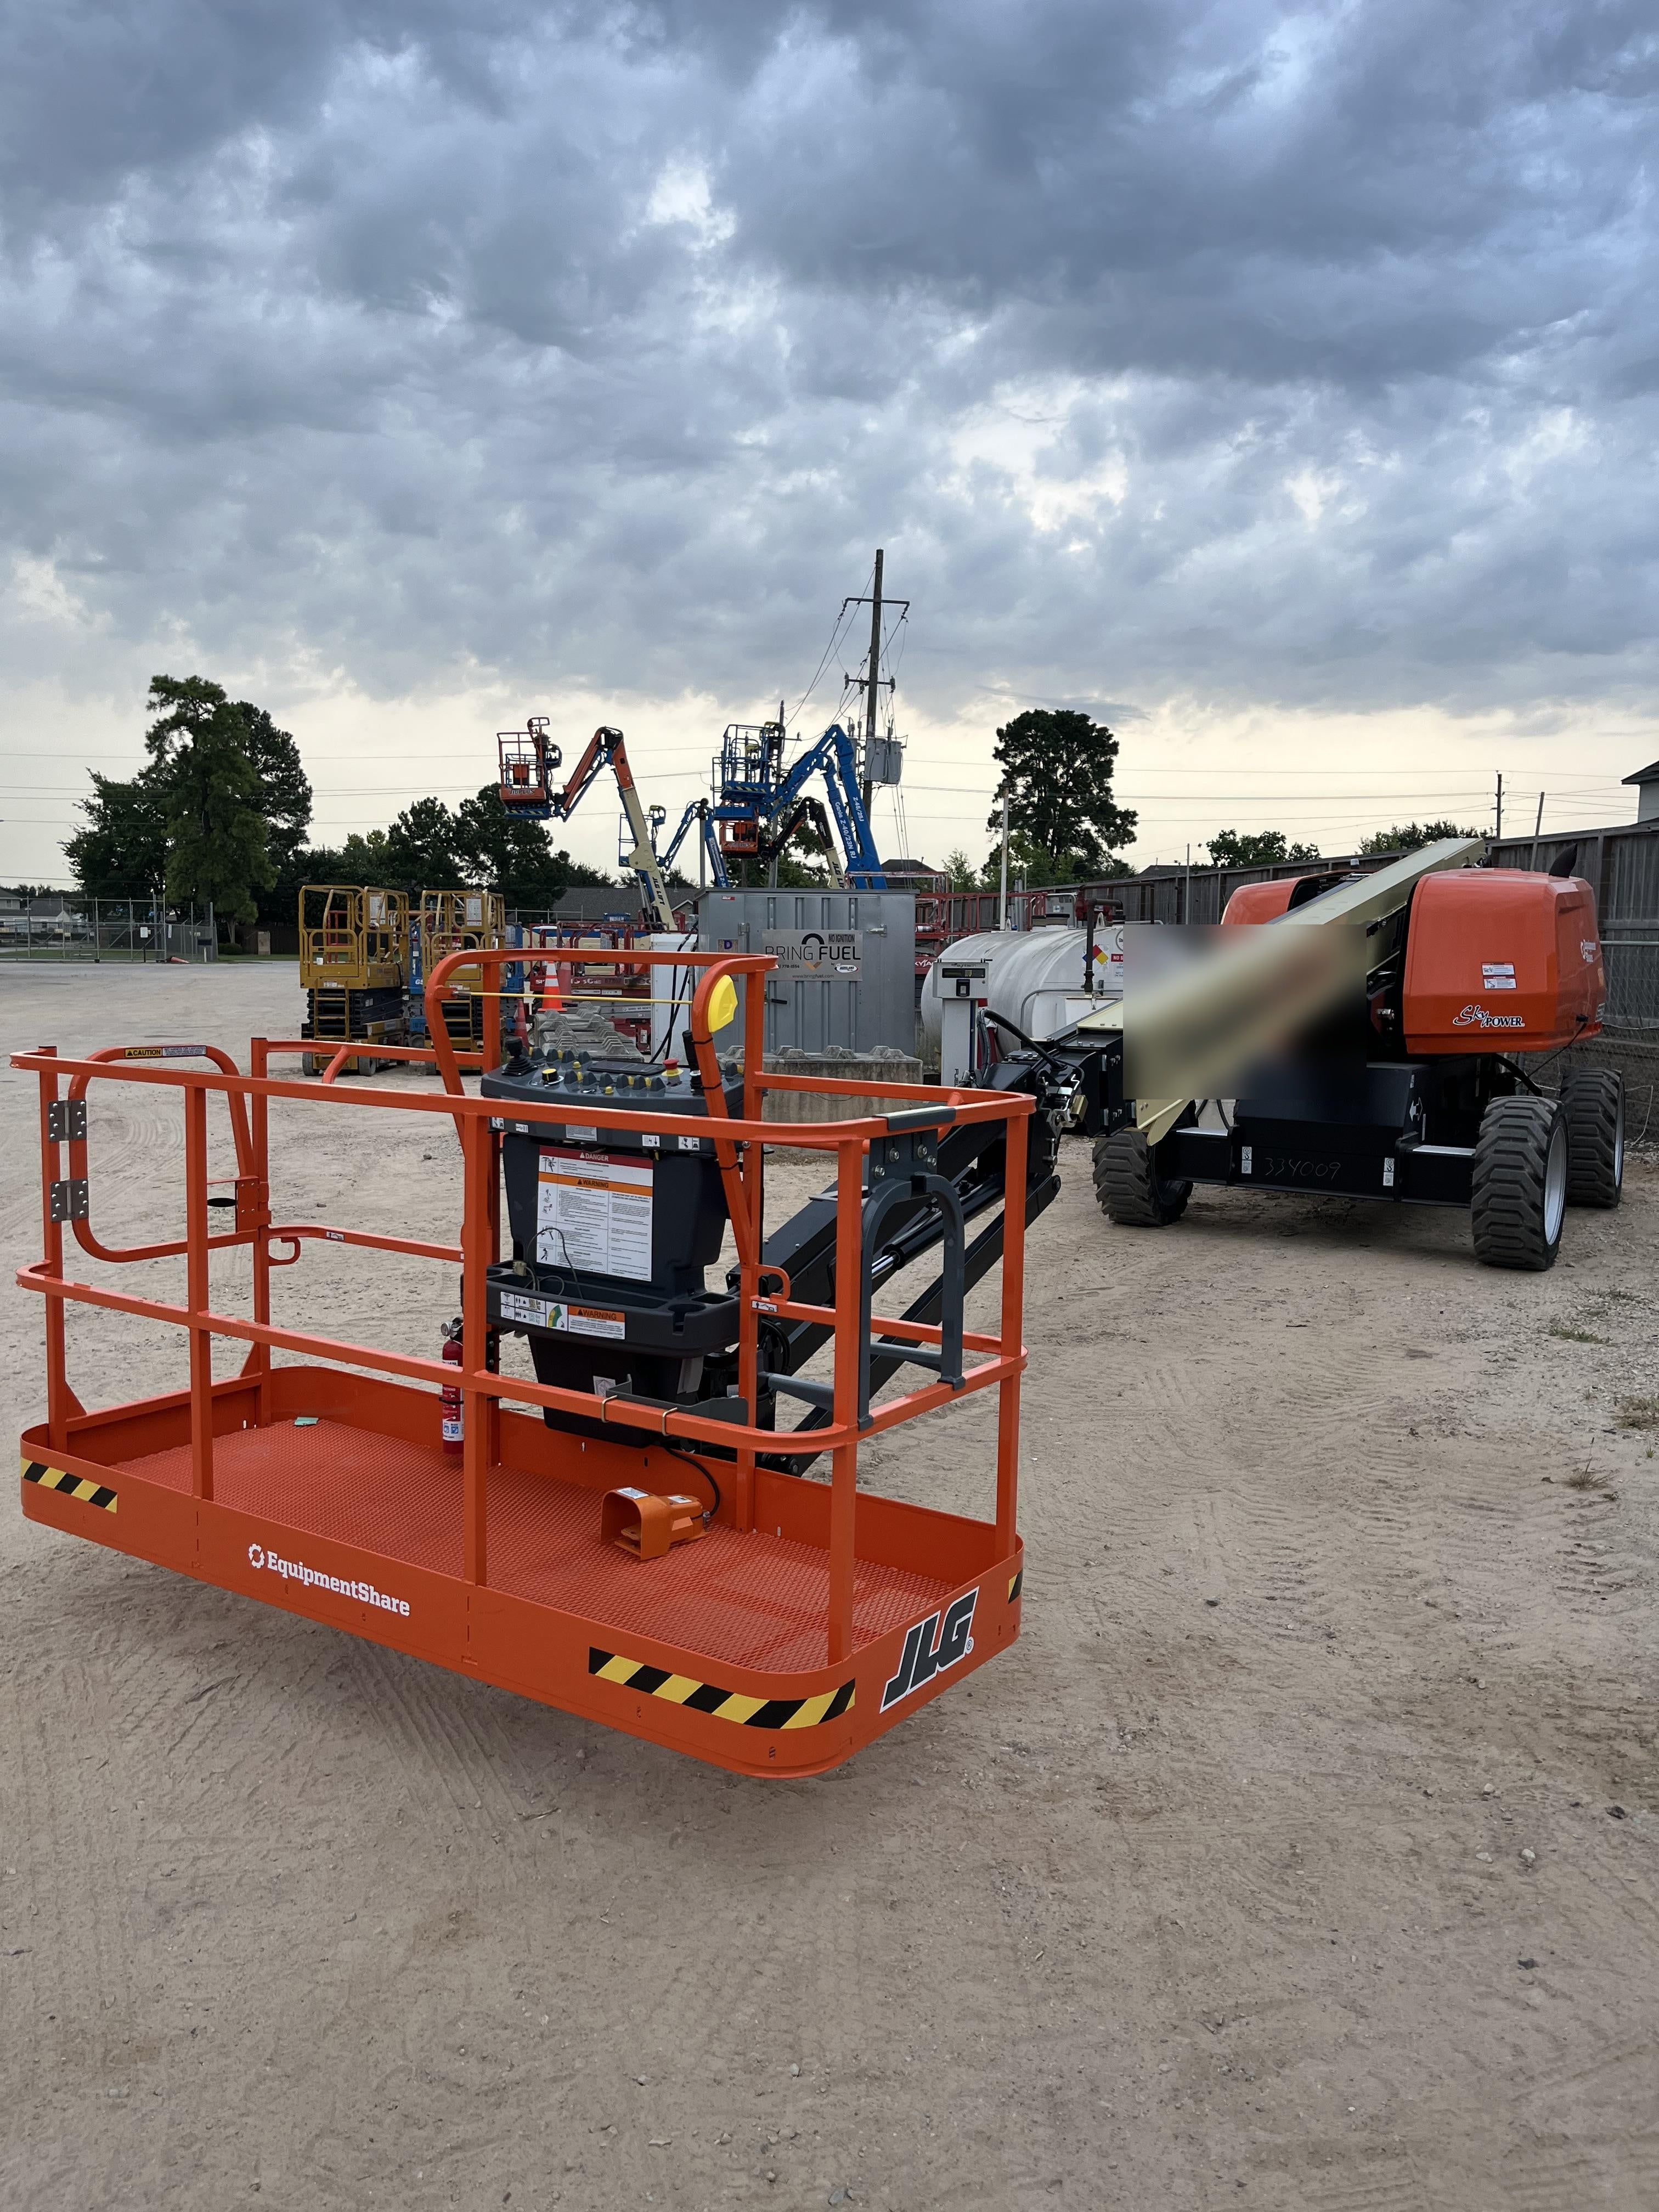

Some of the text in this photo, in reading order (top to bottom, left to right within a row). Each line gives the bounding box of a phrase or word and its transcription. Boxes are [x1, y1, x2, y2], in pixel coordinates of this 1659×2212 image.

[835, 802, 843, 819] Genie
[840, 819, 854, 850] Z-40/23N
[832, 861, 842, 876] JLG
[828, 934, 855, 943] NO IGNITION
[765, 946, 861, 960] BRING FUEL
[585, 1153, 609, 1162] DANGER
[1265, 1157, 1341, 1180] 334009
[583, 1179, 609, 1188] WARNING
[583, 1309, 617, 1321] WARNING
[267, 1550, 410, 1617] EquipmentShare
[879, 1585, 980, 1711] JLG
